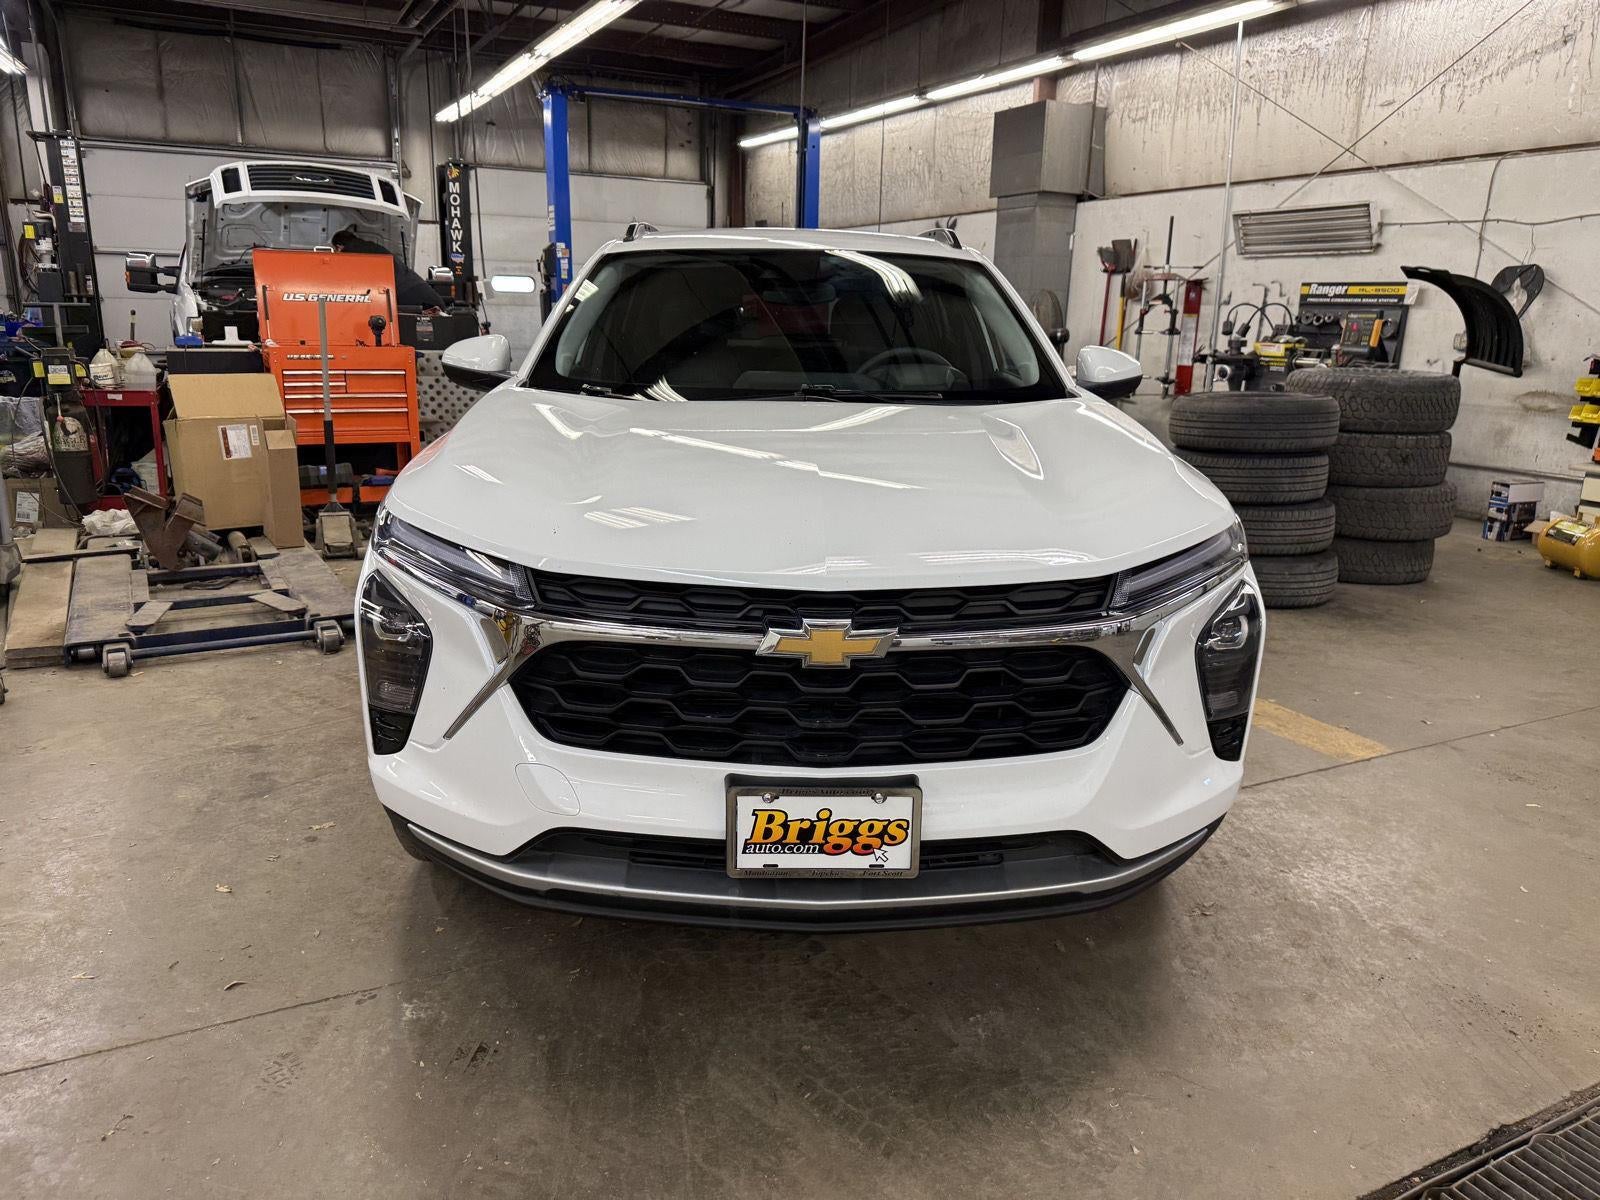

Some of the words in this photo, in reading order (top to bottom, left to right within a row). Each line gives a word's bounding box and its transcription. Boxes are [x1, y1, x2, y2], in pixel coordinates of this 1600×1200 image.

[448, 182, 463, 253] MOHAWK
[1309, 283, 1348, 296] Ranger
[308, 293, 372, 303] GENERAL
[745, 808, 910, 856] Briggs
[745, 843, 819, 854] auto.com
